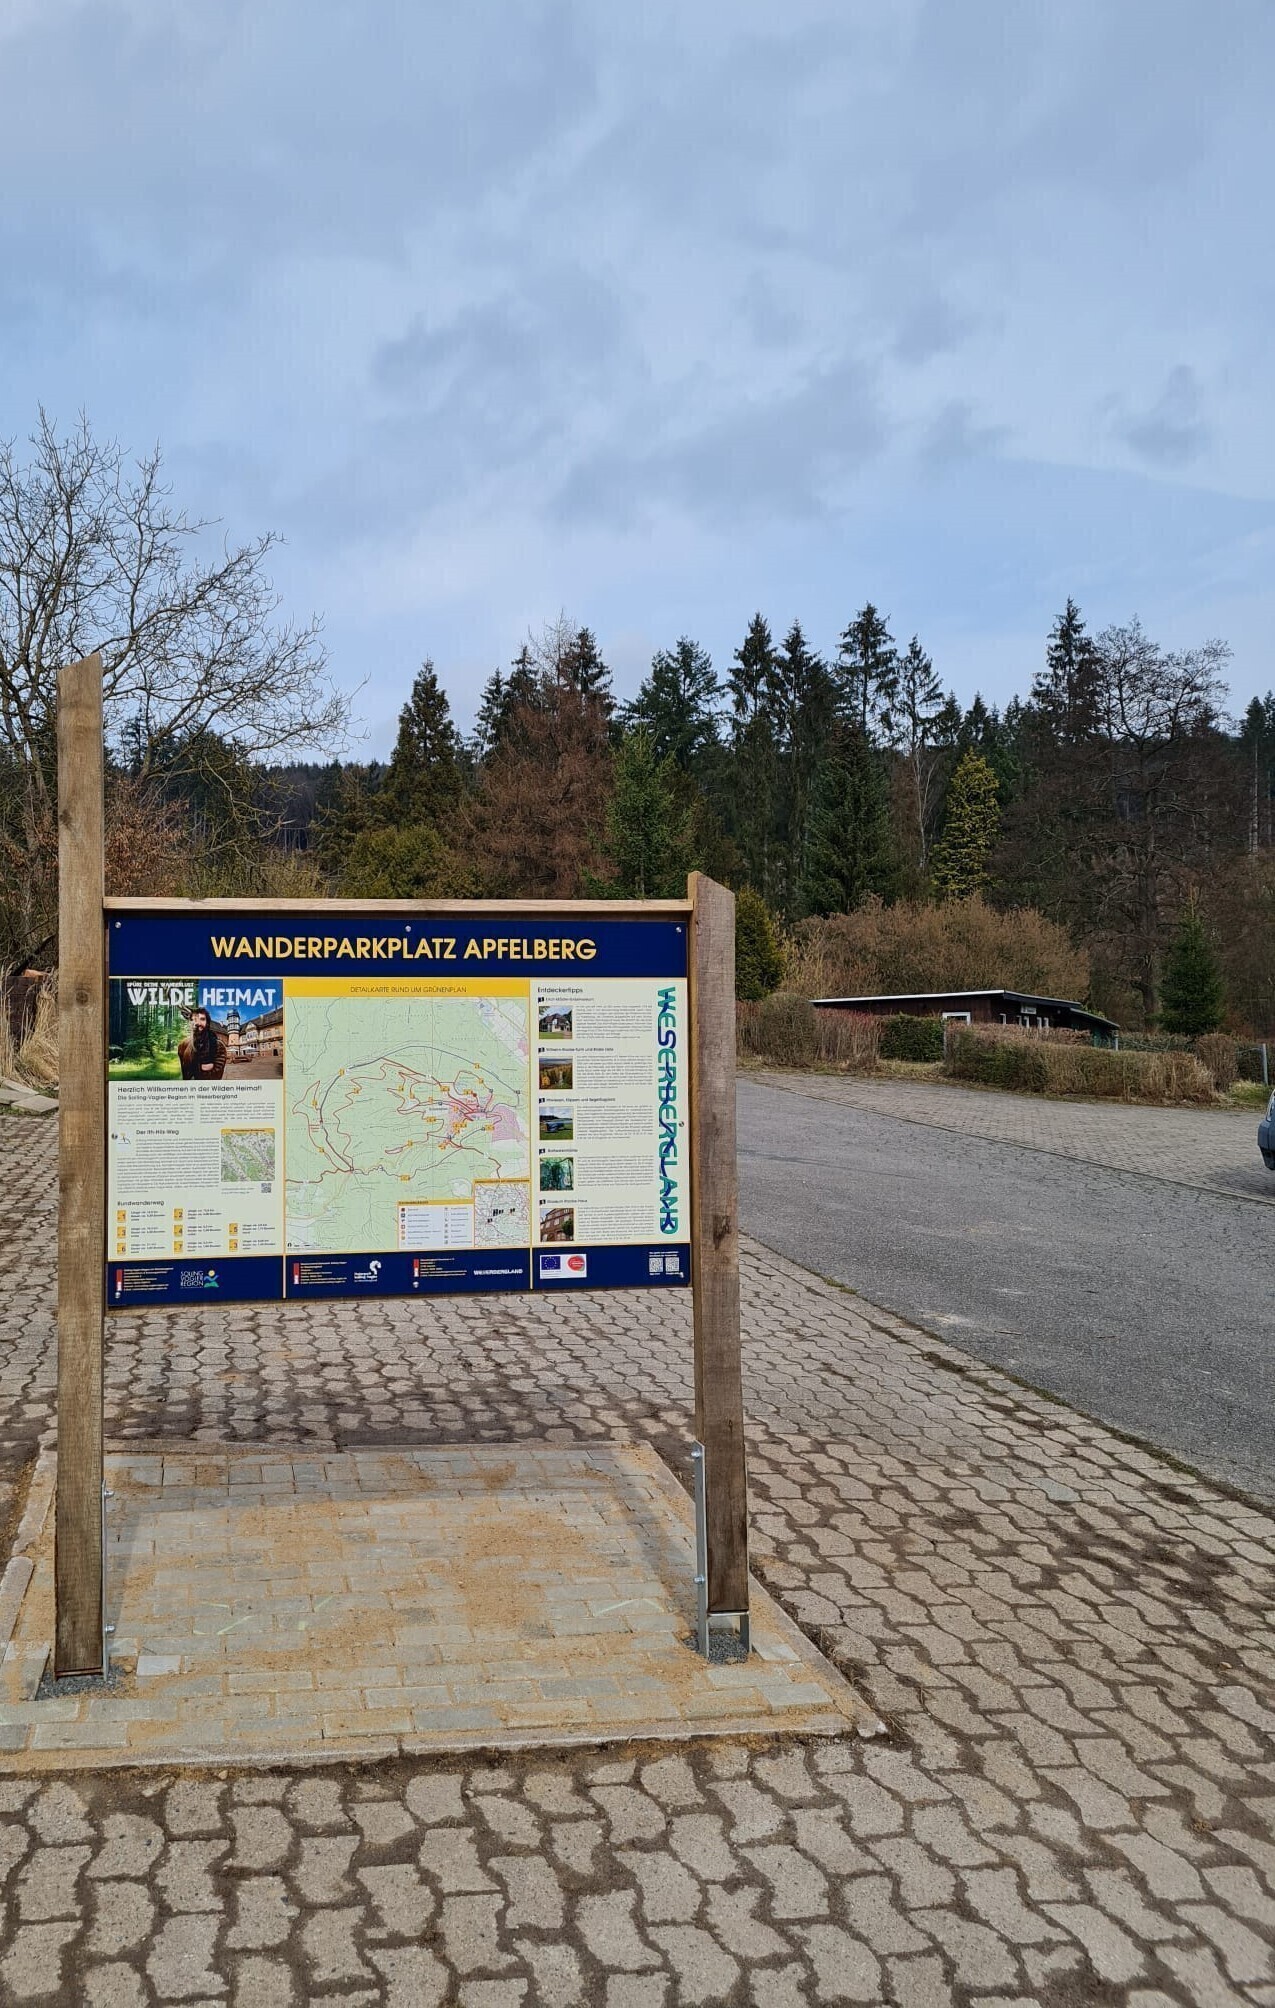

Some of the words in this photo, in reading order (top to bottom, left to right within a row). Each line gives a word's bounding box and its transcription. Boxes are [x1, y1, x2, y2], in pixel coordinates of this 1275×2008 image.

[210, 936, 456, 960] WANDERPARKPLATZ
[463, 938, 598, 960] APFELBERG
[423, 985, 467, 993] GRÜNENPLAN
[537, 986, 583, 994] Entdeckertipps
[127, 987, 194, 1006] WILDE
[202, 988, 276, 1006] HEIMAT
[146, 1085, 189, 1093] Willkommen
[657, 986, 679, 1235] WESERBERGLAND
